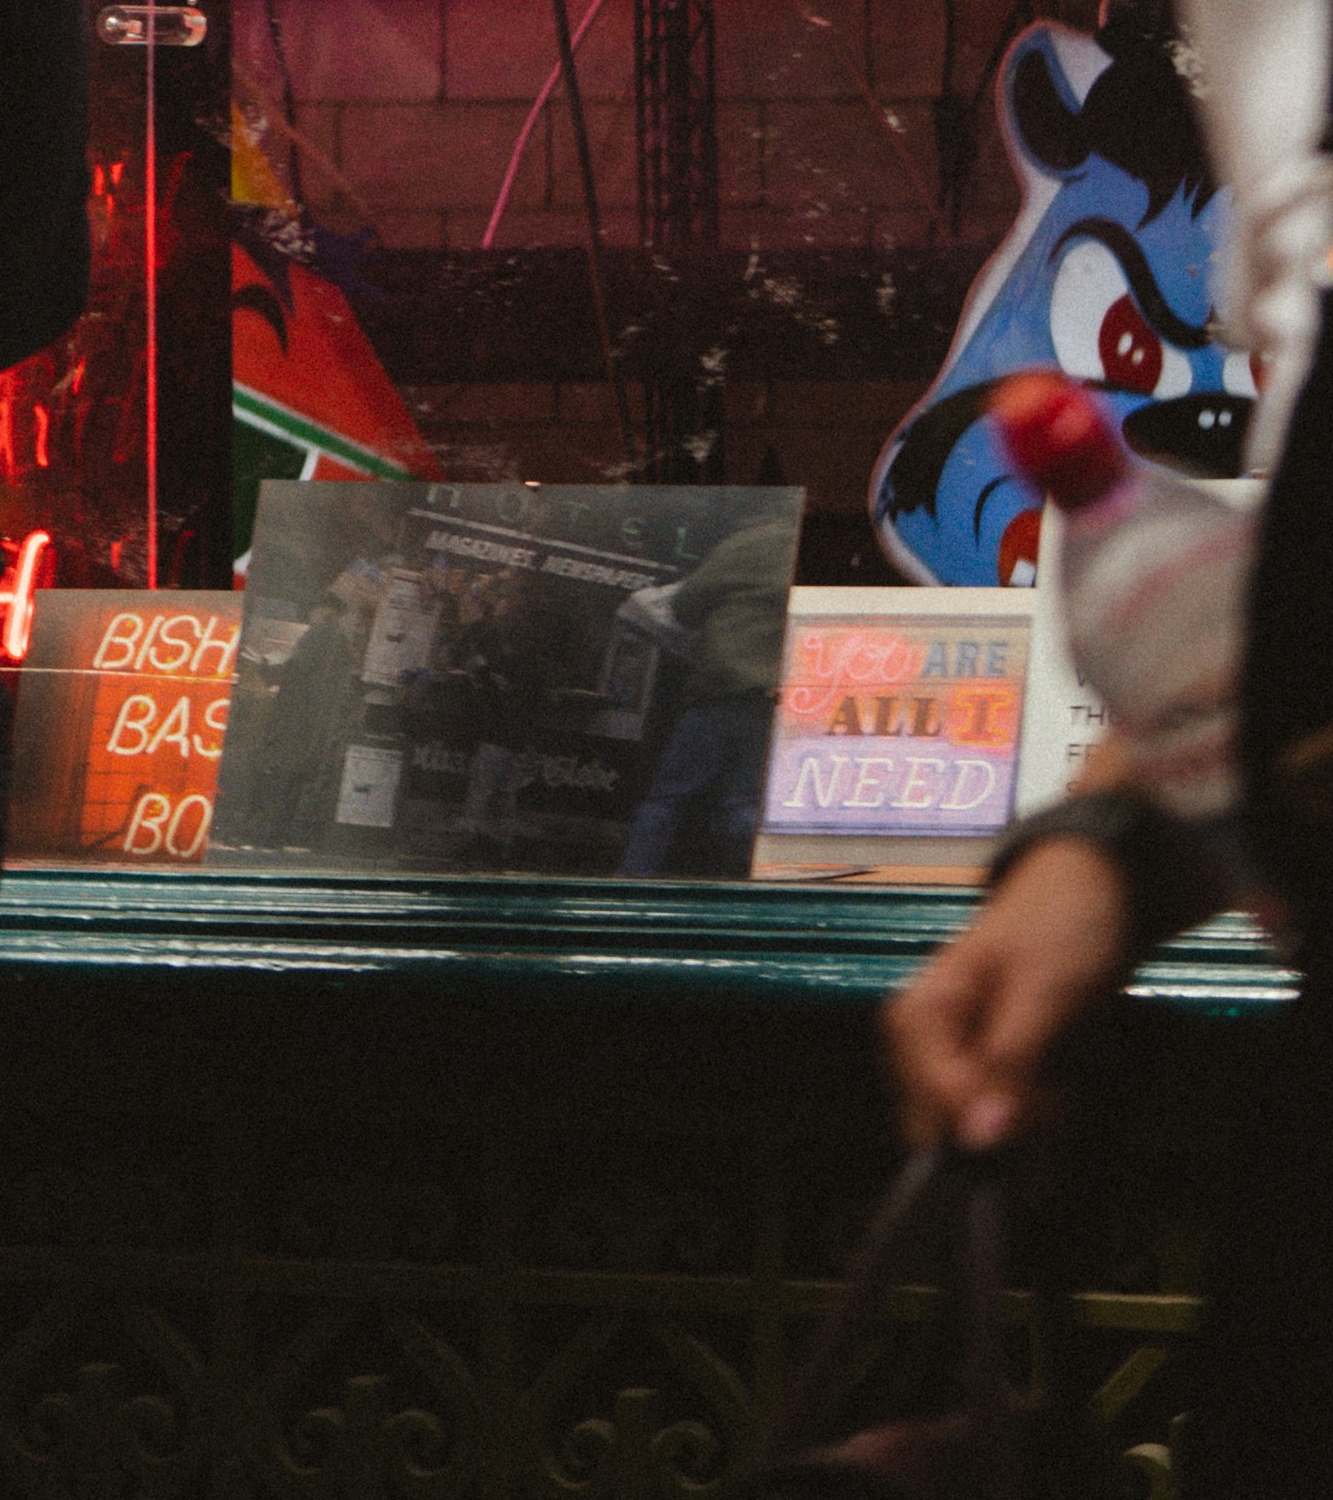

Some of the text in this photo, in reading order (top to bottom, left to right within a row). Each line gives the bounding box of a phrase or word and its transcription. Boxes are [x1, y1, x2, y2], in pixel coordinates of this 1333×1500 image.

[92, 611, 241, 676] BISH
[922, 640, 1011, 678] ARE
[826, 687, 1017, 748] ALL I
[779, 753, 998, 812] NEED
[122, 792, 213, 859] BO
